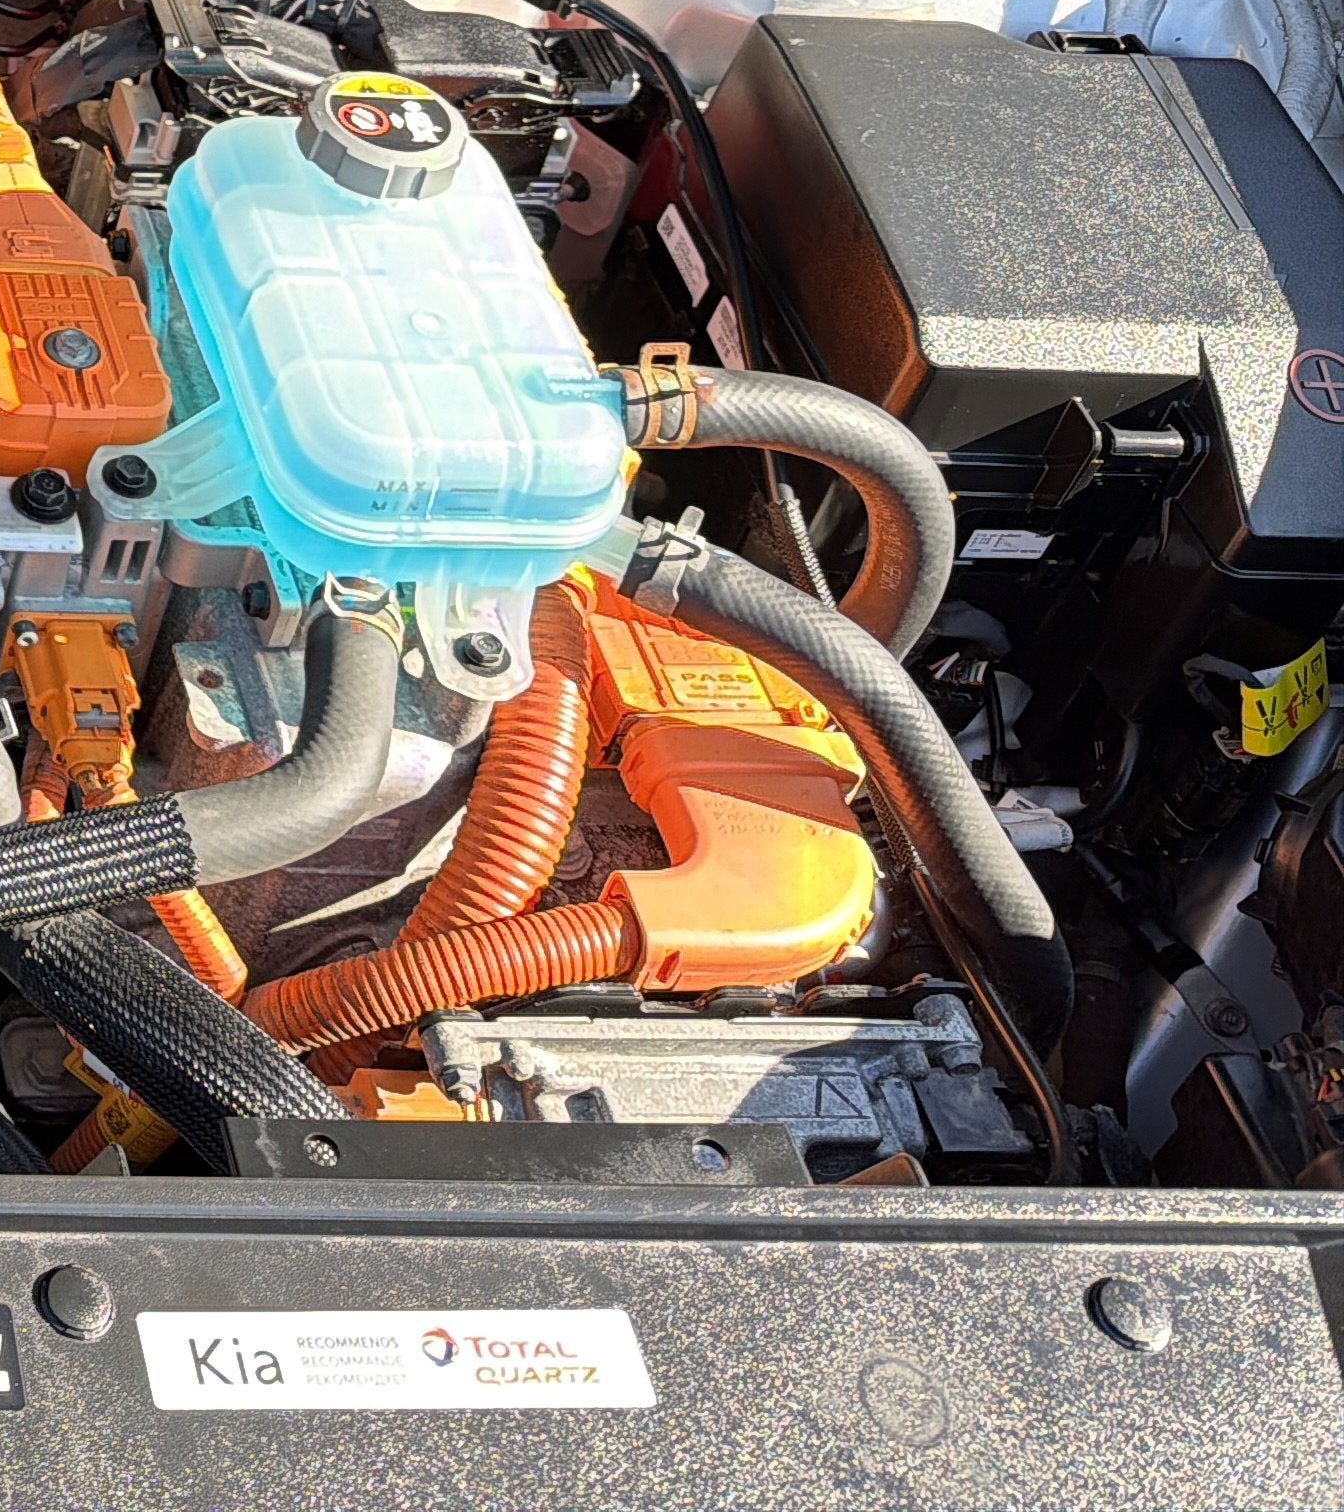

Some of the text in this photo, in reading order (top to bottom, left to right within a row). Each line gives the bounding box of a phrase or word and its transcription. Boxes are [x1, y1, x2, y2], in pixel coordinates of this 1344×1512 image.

[376, 480, 427, 493] MAX
[680, 672, 754, 684] PASS
[297, 1336, 399, 1350] RECOMMENDS
[463, 1336, 578, 1359] TOTAL
[188, 1337, 285, 1386] Kia
[301, 1355, 404, 1368] RECOMMANDE
[475, 1366, 600, 1386] QUARTZ
